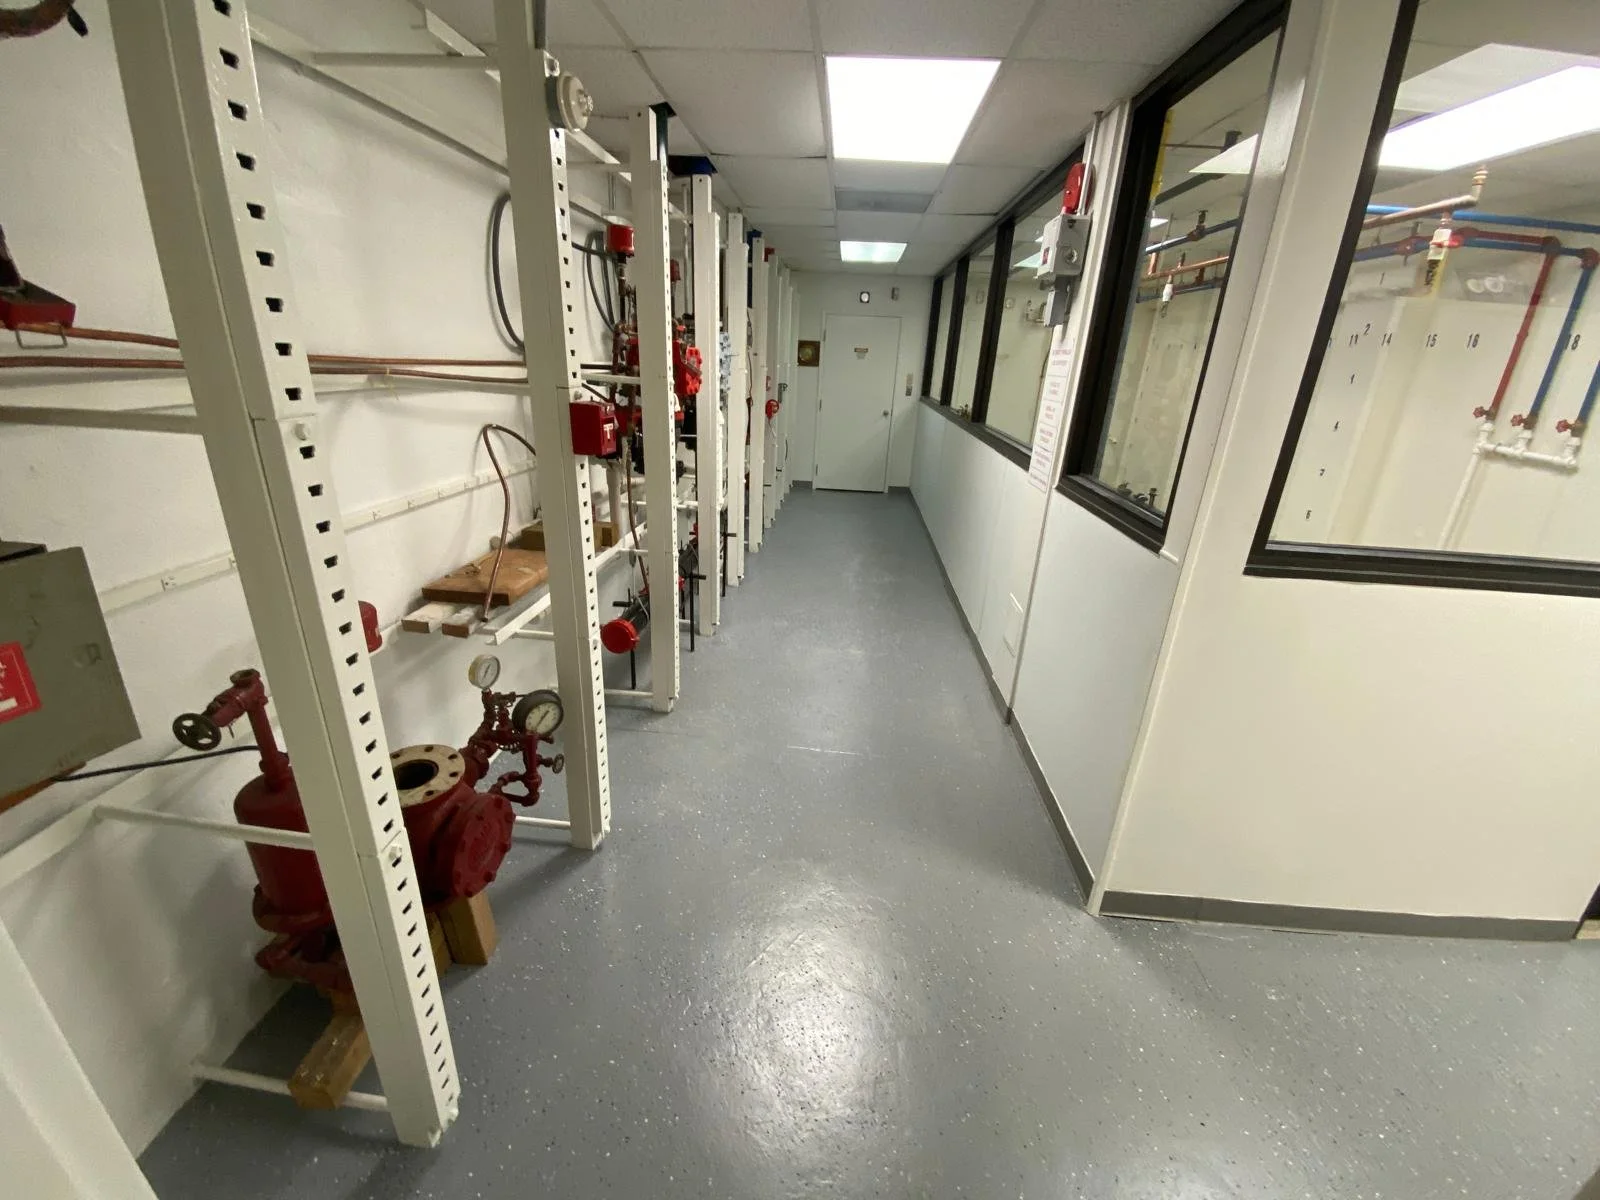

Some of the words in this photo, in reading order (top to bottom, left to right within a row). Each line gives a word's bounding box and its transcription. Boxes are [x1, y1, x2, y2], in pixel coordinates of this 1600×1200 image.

[1381, 332, 1392, 347] 14
[1426, 333, 1438, 348] 15
[1467, 333, 1480, 349] 16
[1564, 333, 1581, 350] 18
